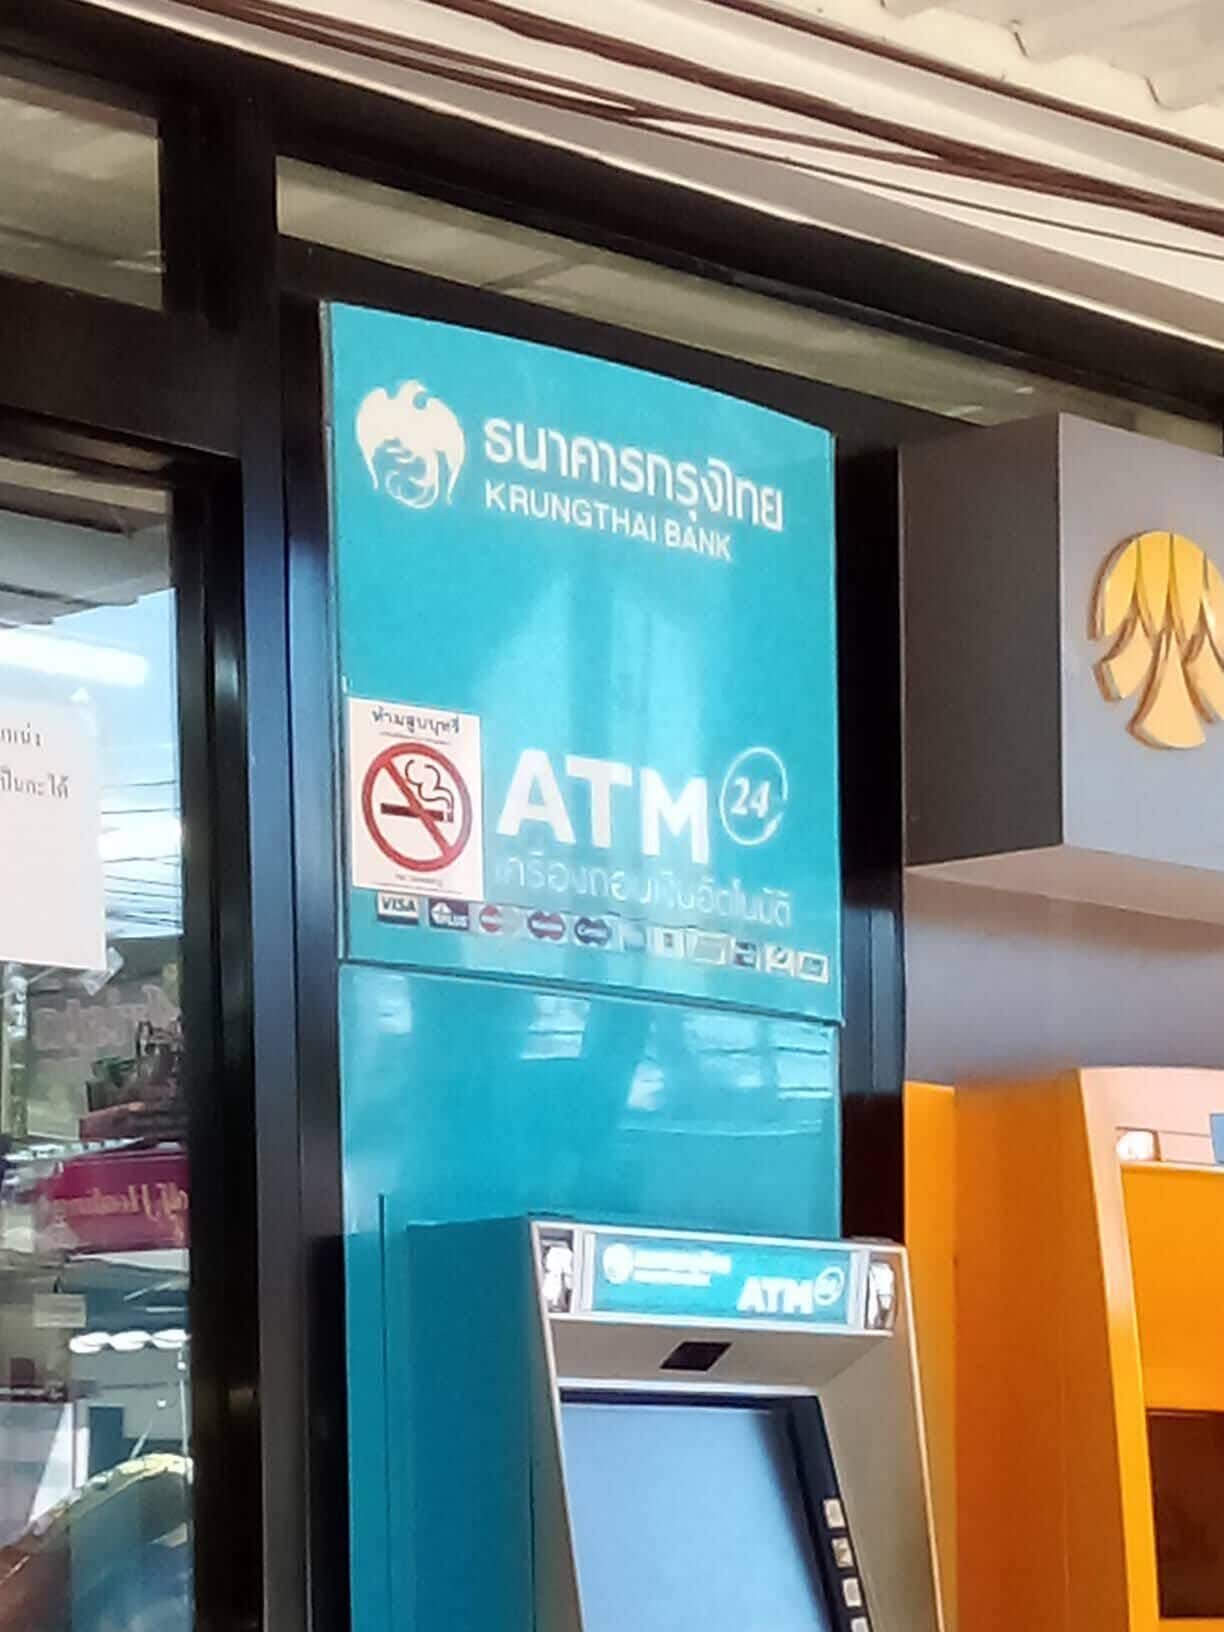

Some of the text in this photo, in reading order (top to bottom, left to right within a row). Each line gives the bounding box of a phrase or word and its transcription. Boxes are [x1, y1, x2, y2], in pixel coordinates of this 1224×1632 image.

[483, 417, 785, 533] ธนาคารกรุงไทย
[484, 479, 733, 562] KRUNGTHAI BANK
[496, 748, 771, 866] ATM 24
[380, 894, 417, 914] VISA
[736, 1275, 815, 1315] ATM
